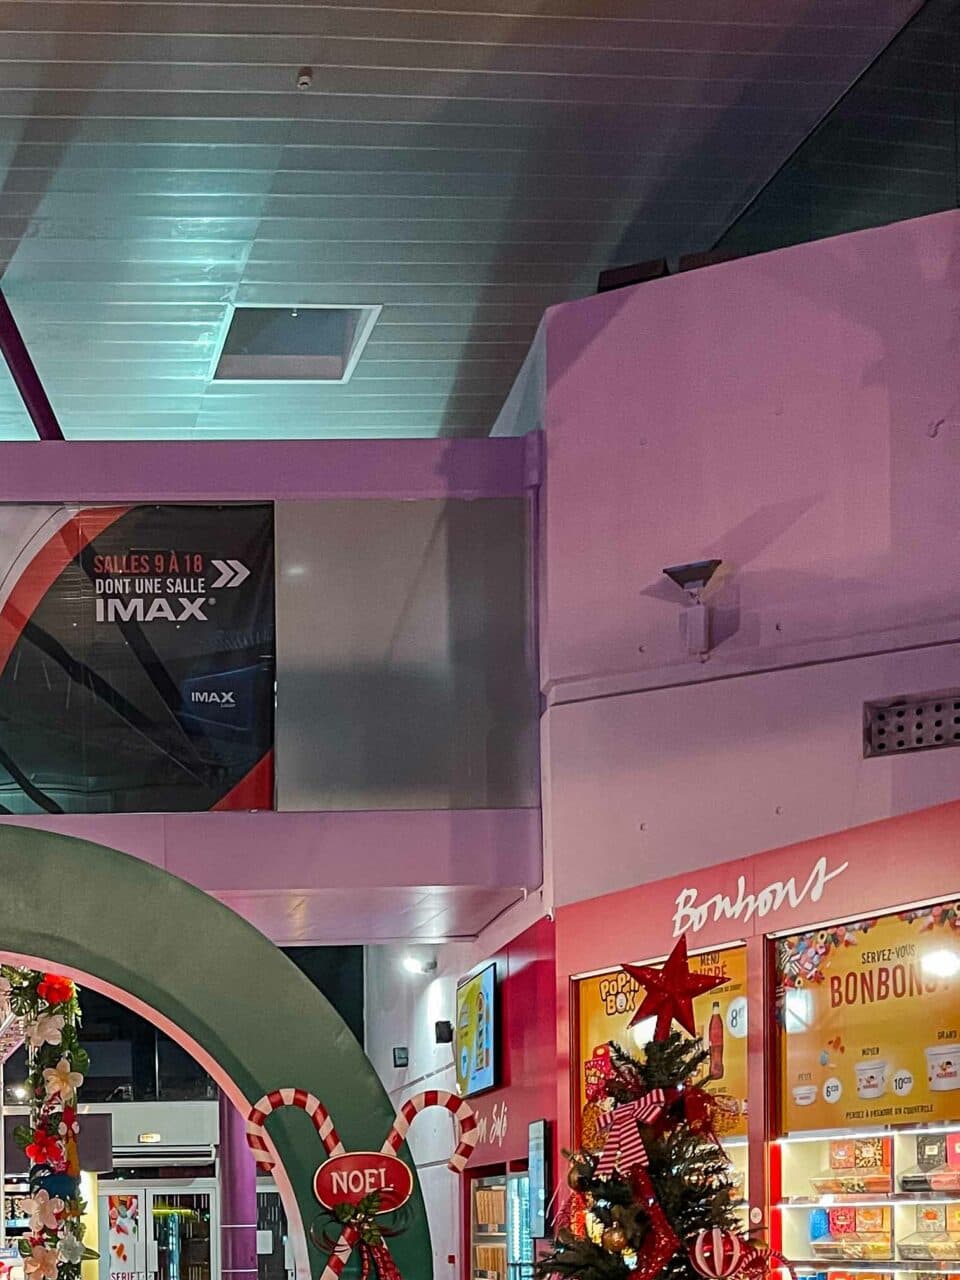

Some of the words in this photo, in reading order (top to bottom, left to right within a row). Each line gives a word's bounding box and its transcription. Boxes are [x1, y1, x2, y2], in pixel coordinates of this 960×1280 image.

[93, 554, 150, 574] SALLES
[155, 554, 164, 573] 9
[168, 549, 179, 574] À
[184, 554, 203, 573] 18
[95, 578, 131, 595] DONT
[135, 578, 162, 594] UNE
[166, 577, 206, 594] SALLE
[95, 598, 209, 622] IMAX
[191, 691, 236, 703] IMAX
[671, 856, 849, 938] Bonbons
[861, 943, 916, 965] SERVEZ-VOUS
[830, 962, 937, 1009] BONBON
[606, 990, 636, 1015] BOX
[330, 1168, 394, 1194] NOEL
